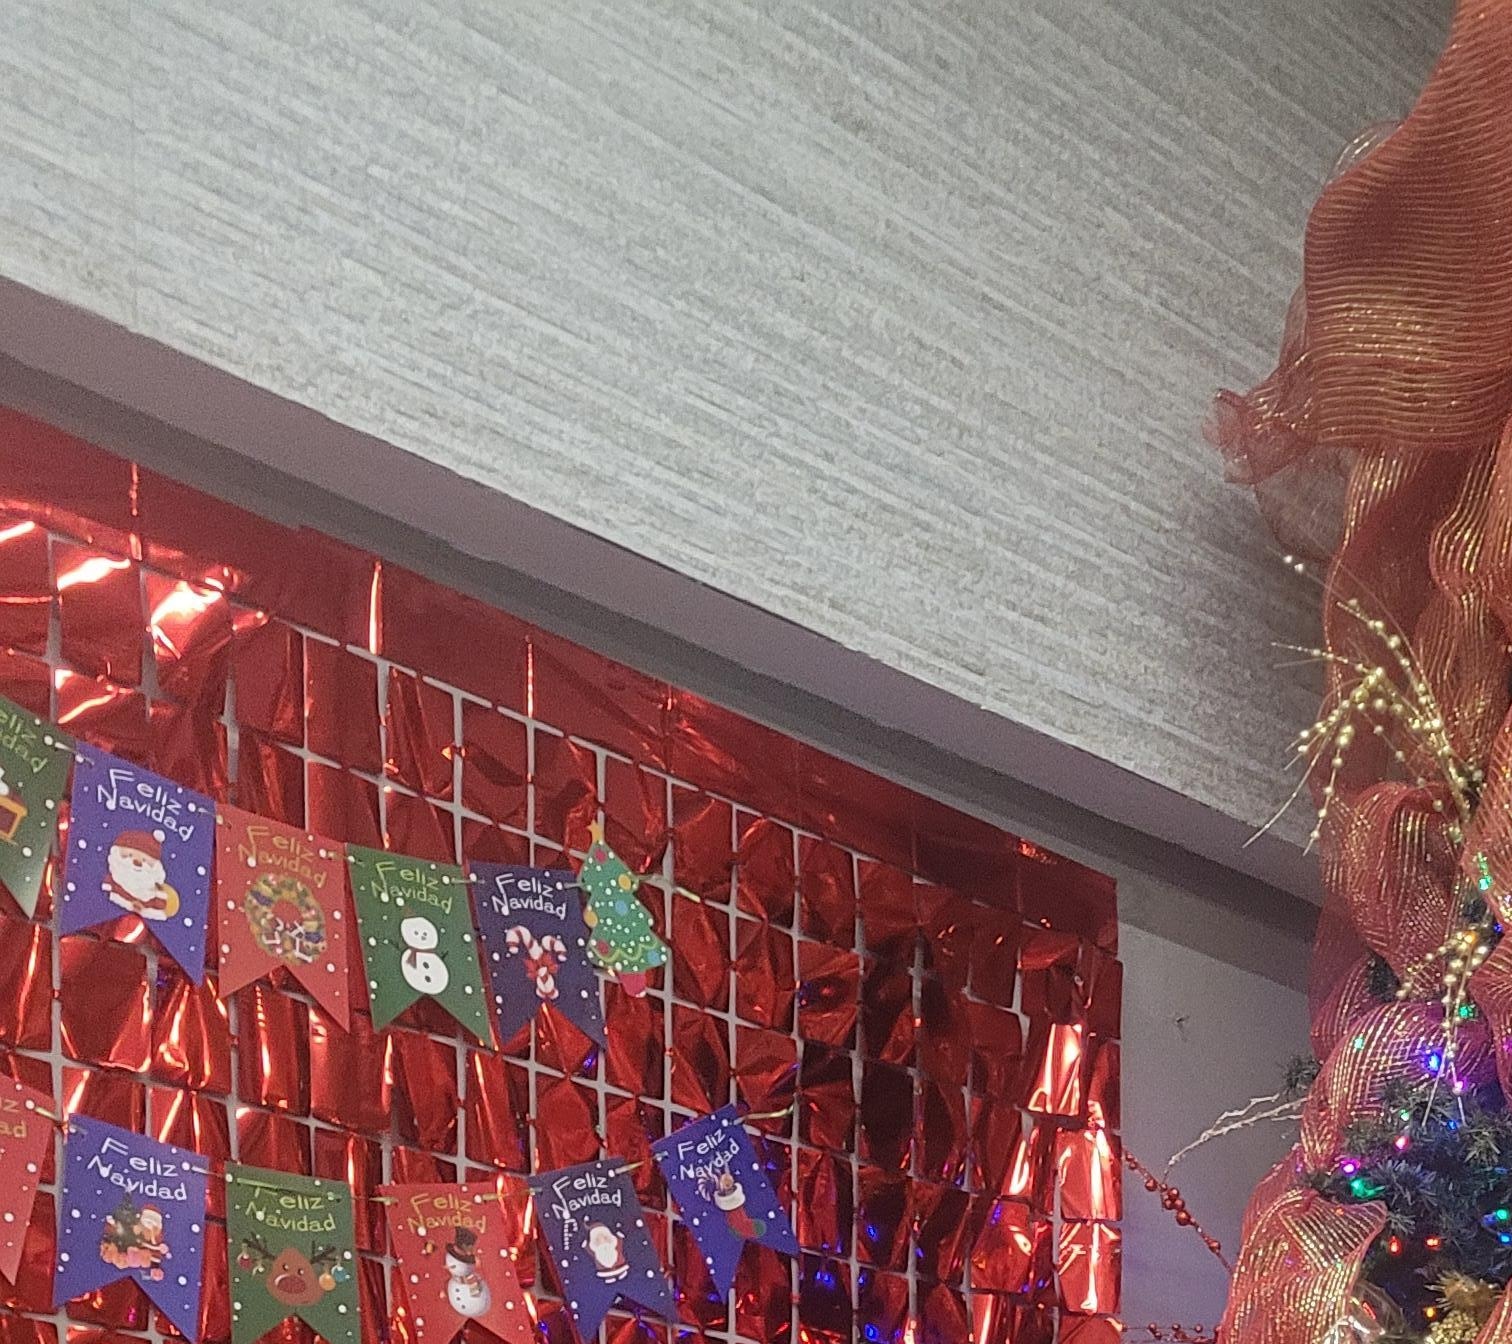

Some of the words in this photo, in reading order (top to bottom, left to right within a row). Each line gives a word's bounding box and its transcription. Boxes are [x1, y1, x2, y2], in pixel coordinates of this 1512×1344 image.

[108, 769, 182, 815] Feliz
[97, 784, 194, 842] Navidad
[246, 826, 314, 864] Feliz
[238, 844, 327, 888] Navidad
[375, 861, 440, 891] Feliz
[371, 880, 453, 914] Navidad
[495, 873, 554, 900] Feliz
[491, 896, 567, 921] Navidad
[101, 1137, 179, 1178] Feliz
[677, 1128, 726, 1161] Feliz
[87, 1156, 188, 1201] Navidad
[552, 1170, 607, 1200] Feliz
[244, 1201, 337, 1233] Navidad
[410, 1193, 472, 1216] Feliz
[551, 1188, 622, 1219] Navidad
[407, 1212, 487, 1234] Navidad
